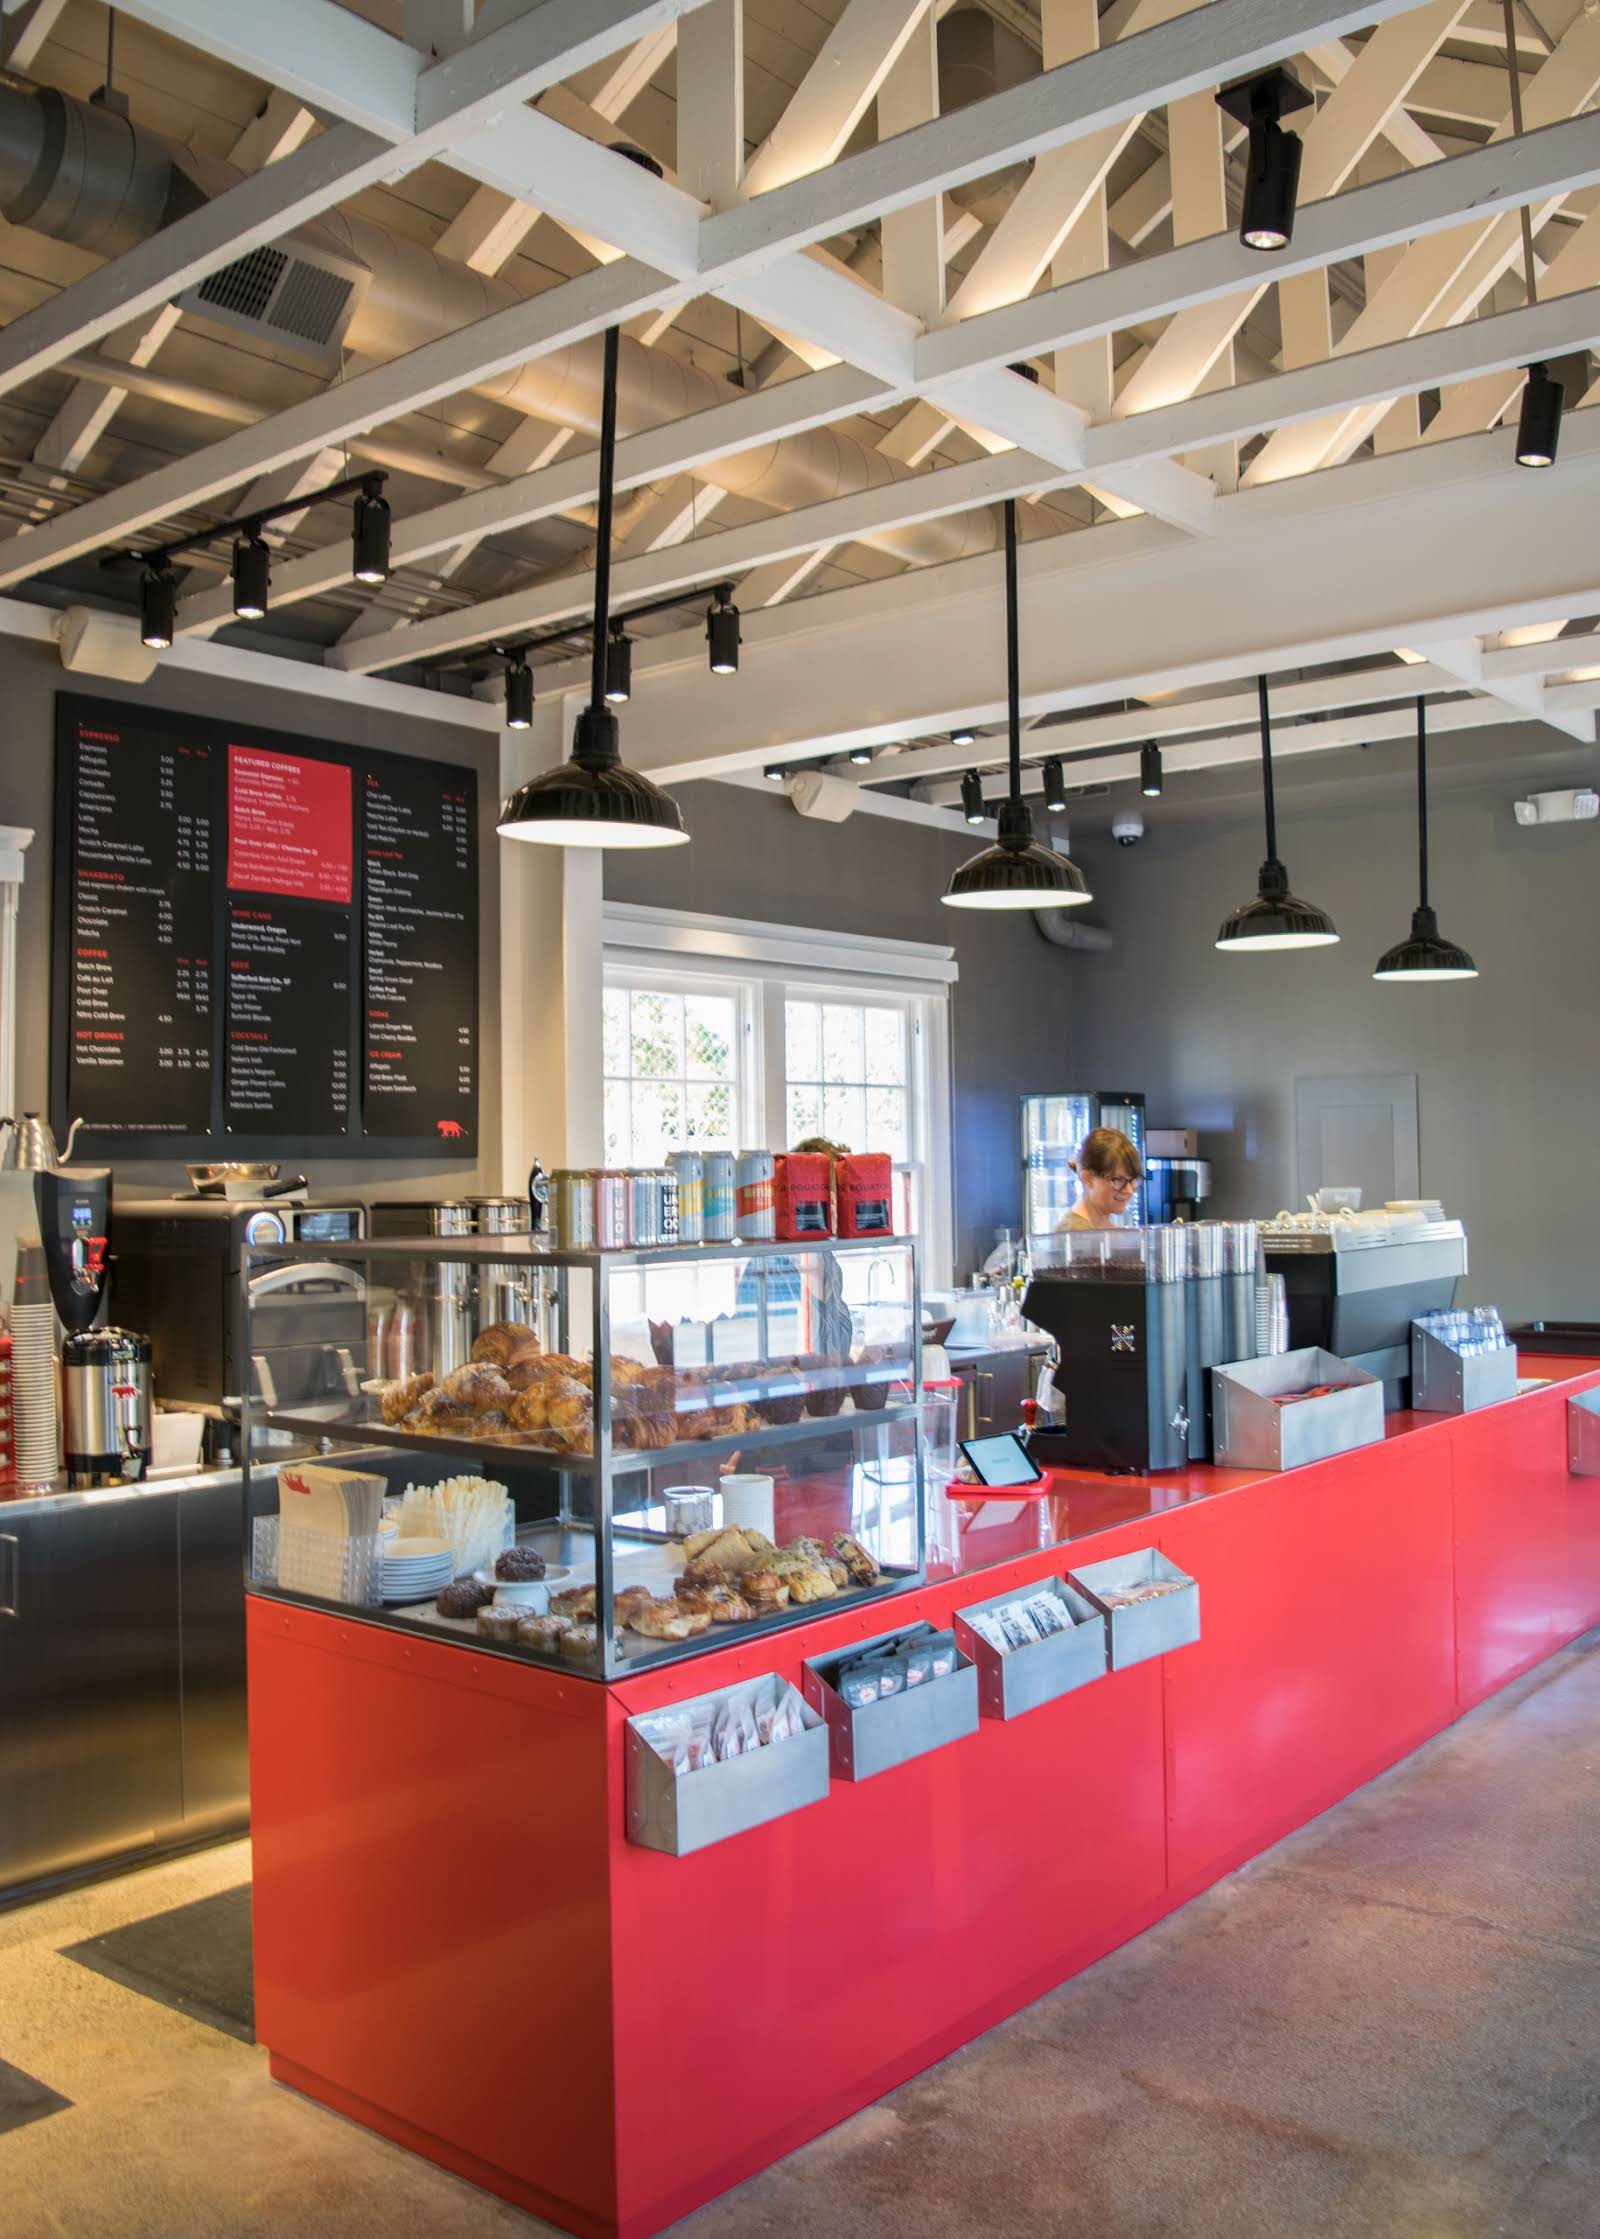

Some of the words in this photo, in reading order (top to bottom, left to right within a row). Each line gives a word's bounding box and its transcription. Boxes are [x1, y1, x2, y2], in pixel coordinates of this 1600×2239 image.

[80, 730, 120, 742] ESPRESSO
[235, 755, 270, 768] FEATURED
[271, 761, 301, 775] COFFEES
[78, 948, 109, 959] COFFEE
[96, 964, 112, 973] Brew
[77, 998, 91, 1007] Cold
[92, 1000, 109, 1009] Brew
[77, 1010, 92, 1019] Nitro
[93, 1011, 108, 1020] Cold
[109, 1013, 126, 1022] Brew
[76, 1031, 92, 1040] HOT
[94, 1032, 125, 1042] DRINKS
[76, 1044, 88, 1053] Hot
[89, 1045, 121, 1055] Chocolate
